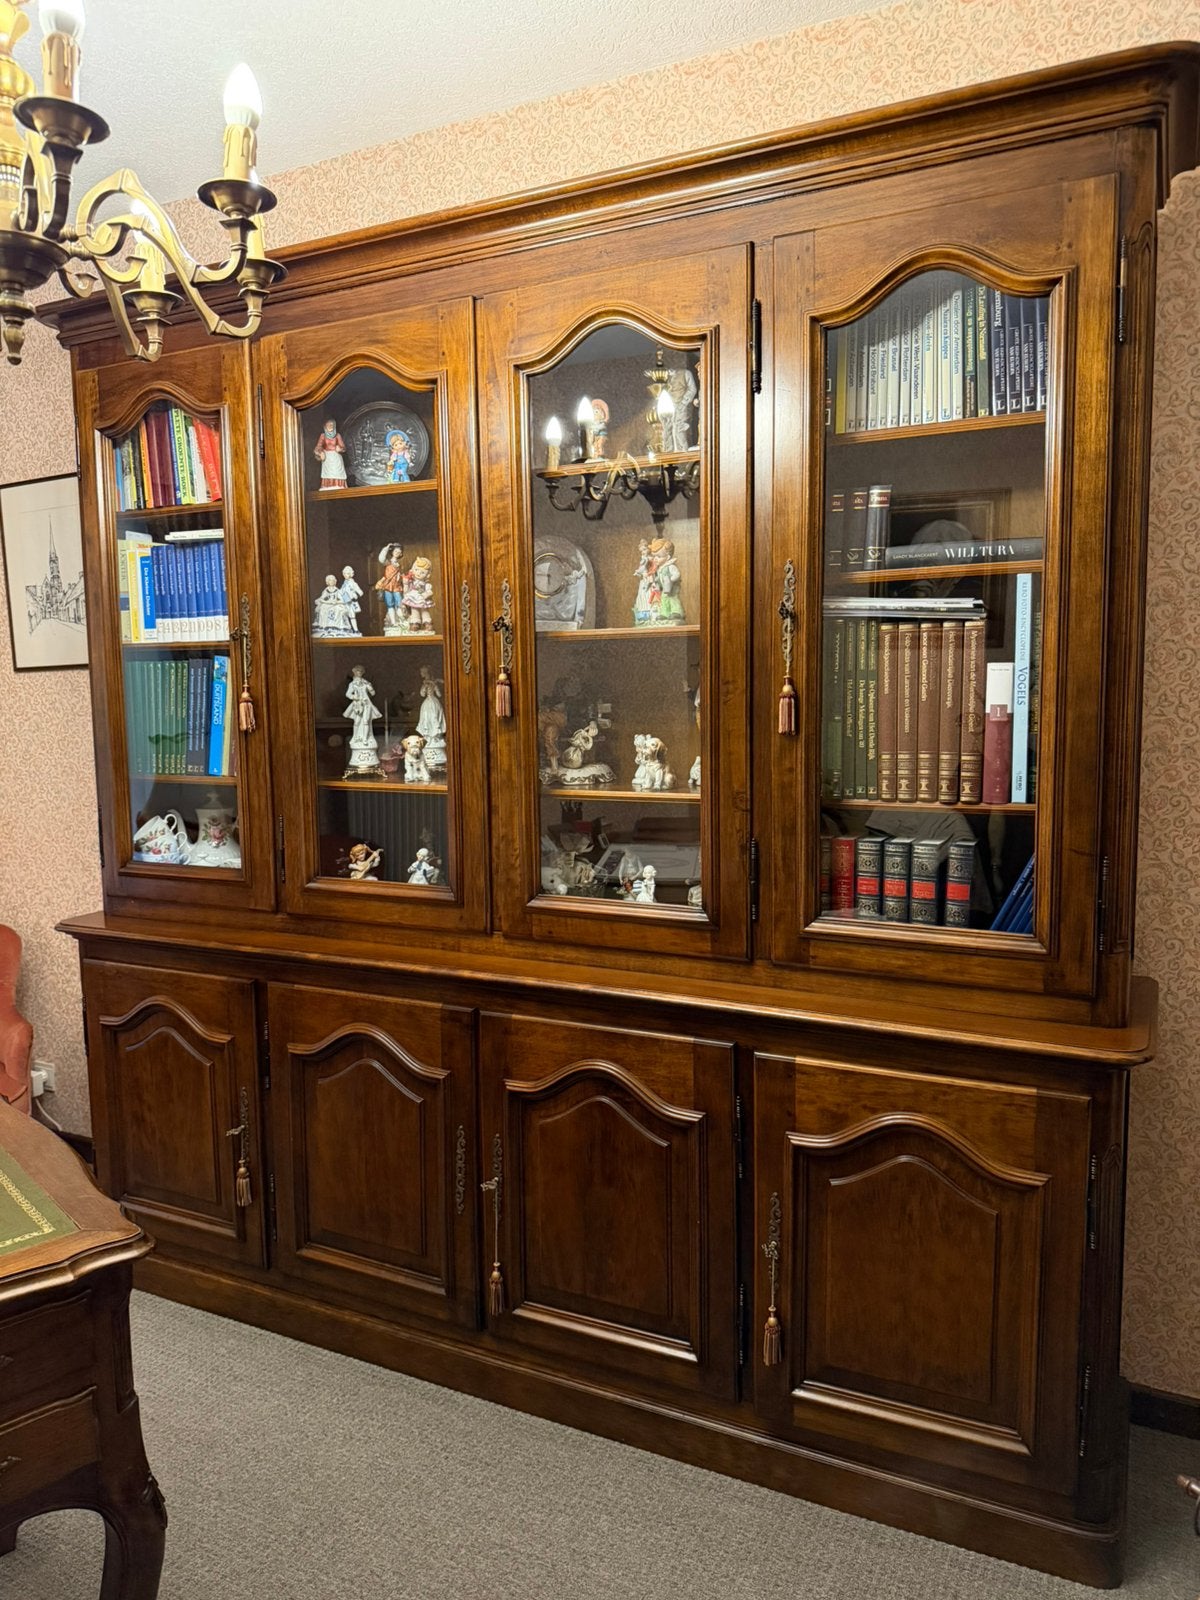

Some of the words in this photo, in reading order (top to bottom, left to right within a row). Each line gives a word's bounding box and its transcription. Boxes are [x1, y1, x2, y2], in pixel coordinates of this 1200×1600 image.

[942, 336, 950, 359] Knippen
[902, 347, 910, 382] Rotterdam
[944, 546, 978, 559] WILL
[978, 544, 1014, 557] TURA
[969, 630, 978, 660] Mysteries
[970, 671, 976, 680] de
[1016, 666, 1028, 706] VOGELS
[946, 679, 954, 708] Dierenrijk
[968, 681, 976, 712] Menselijke
[996, 707, 1000, 717] 1
